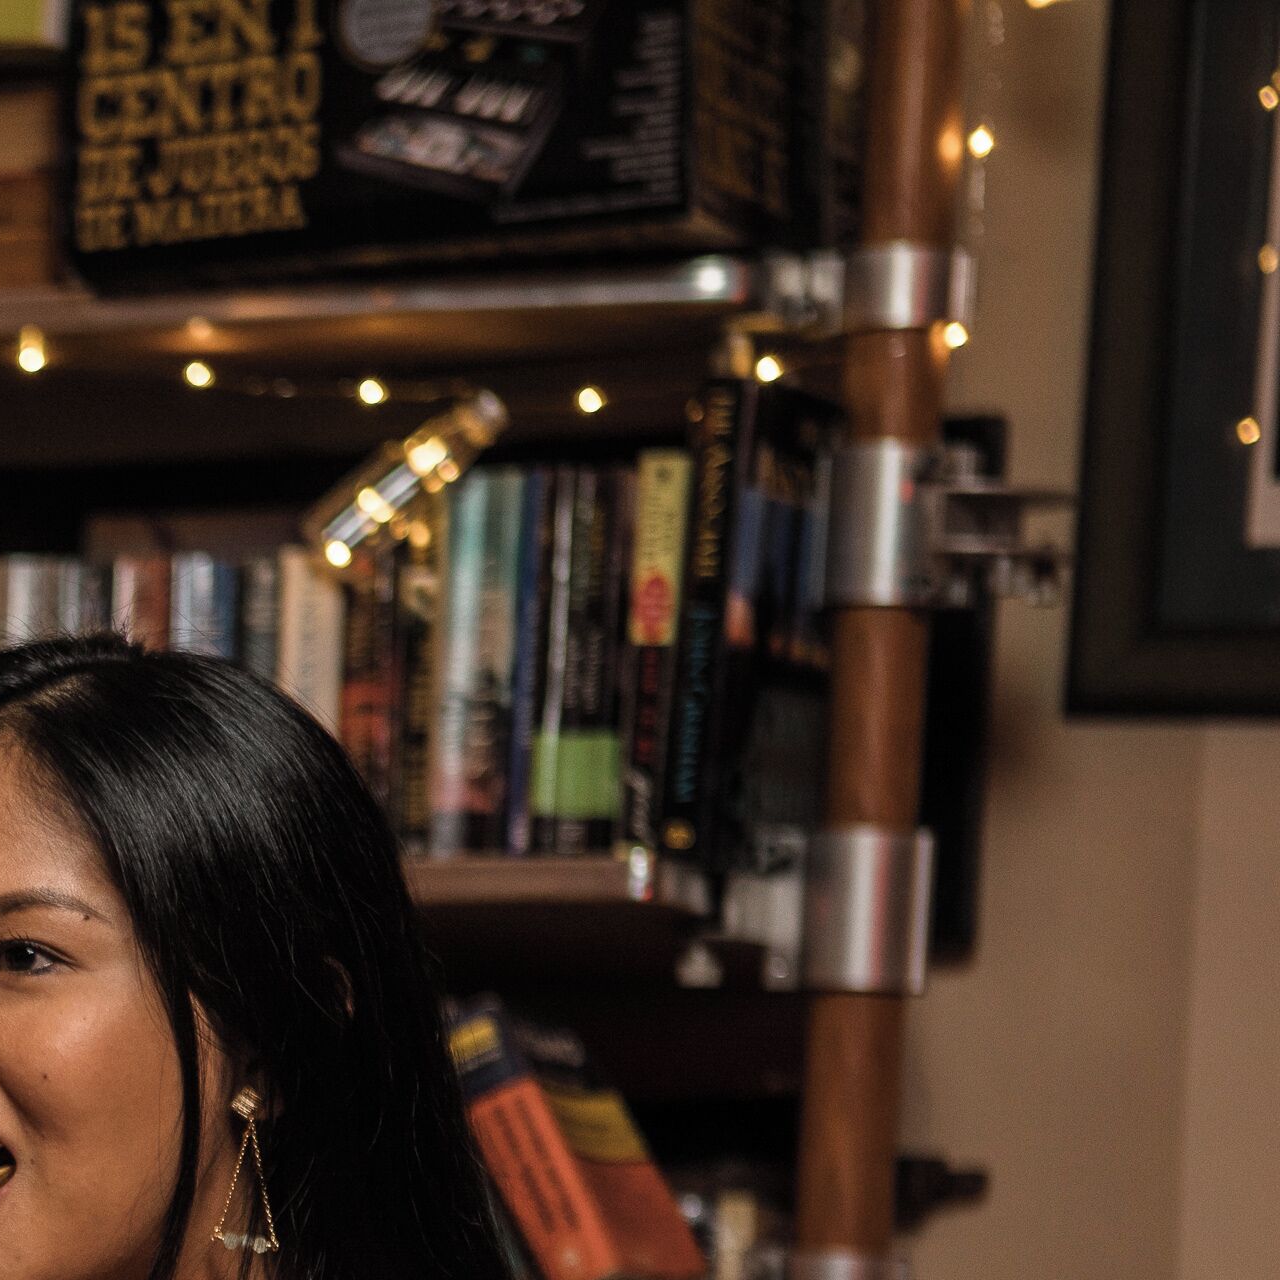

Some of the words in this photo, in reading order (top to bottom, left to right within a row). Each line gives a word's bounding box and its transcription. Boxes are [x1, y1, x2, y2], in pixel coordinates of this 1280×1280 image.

[162, 0, 278, 64] EN
[77, 50, 324, 142] CENTRO
[77, 144, 142, 202] DE
[147, 121, 322, 195] JUEGOS
